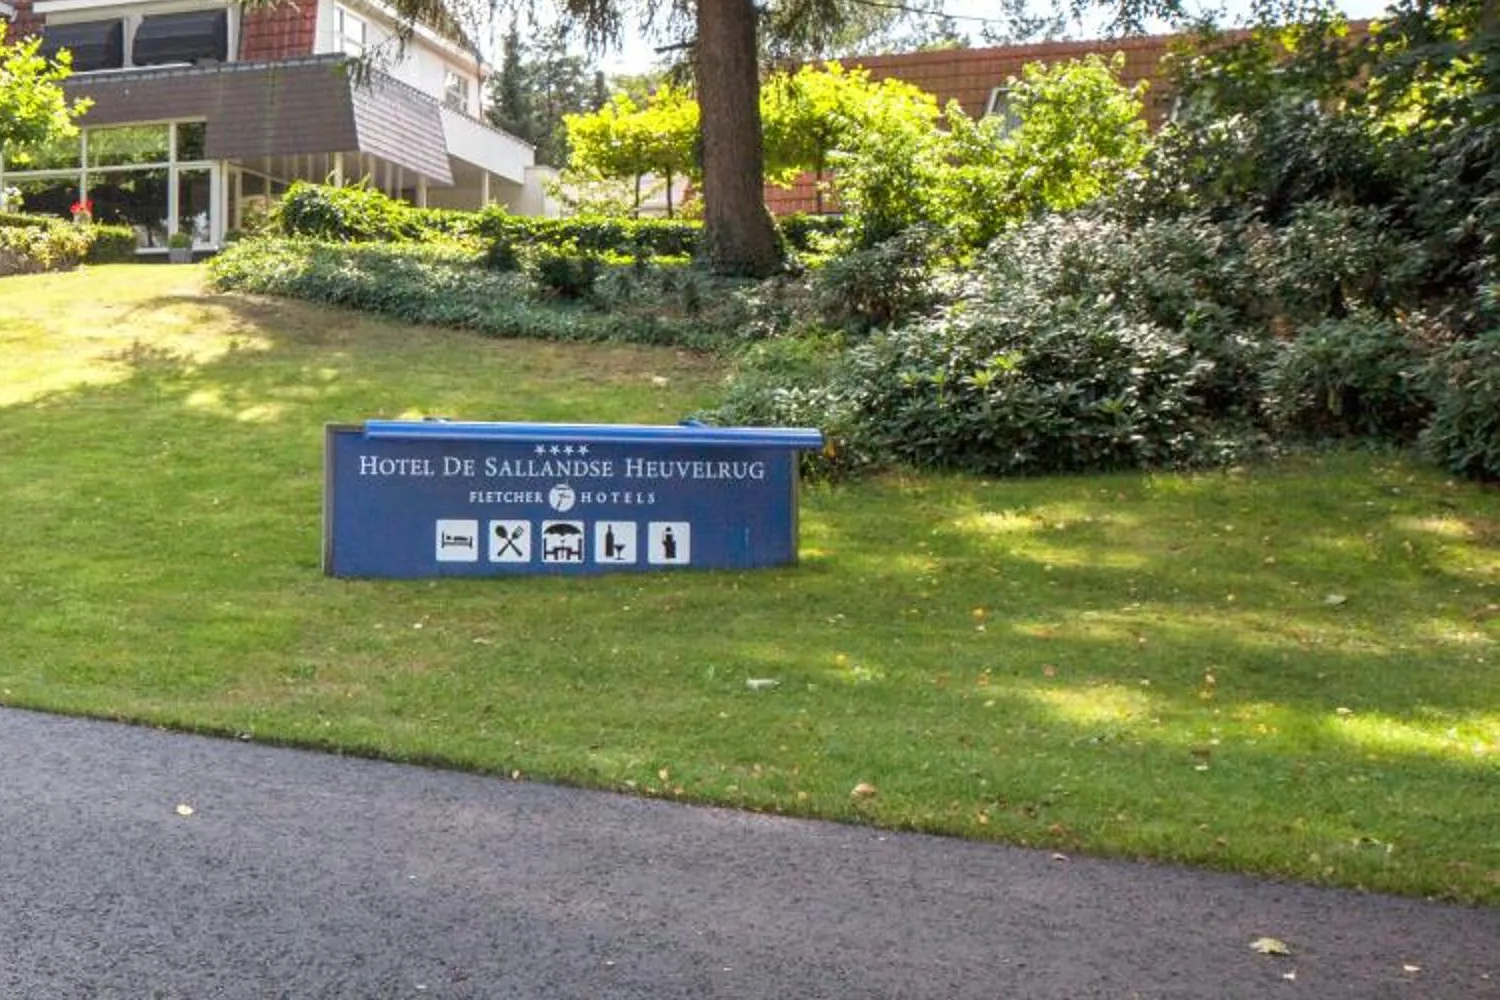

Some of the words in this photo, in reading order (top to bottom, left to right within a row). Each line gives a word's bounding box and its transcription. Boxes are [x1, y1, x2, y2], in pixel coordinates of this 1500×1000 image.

[359, 455, 435, 477] HOTEL
[443, 456, 475, 477] DE
[485, 457, 614, 478] SALLANDSE
[625, 458, 765, 480] HEUVELRUG
[469, 491, 544, 503] FLETCHER
[581, 491, 655, 504] HOTELS
